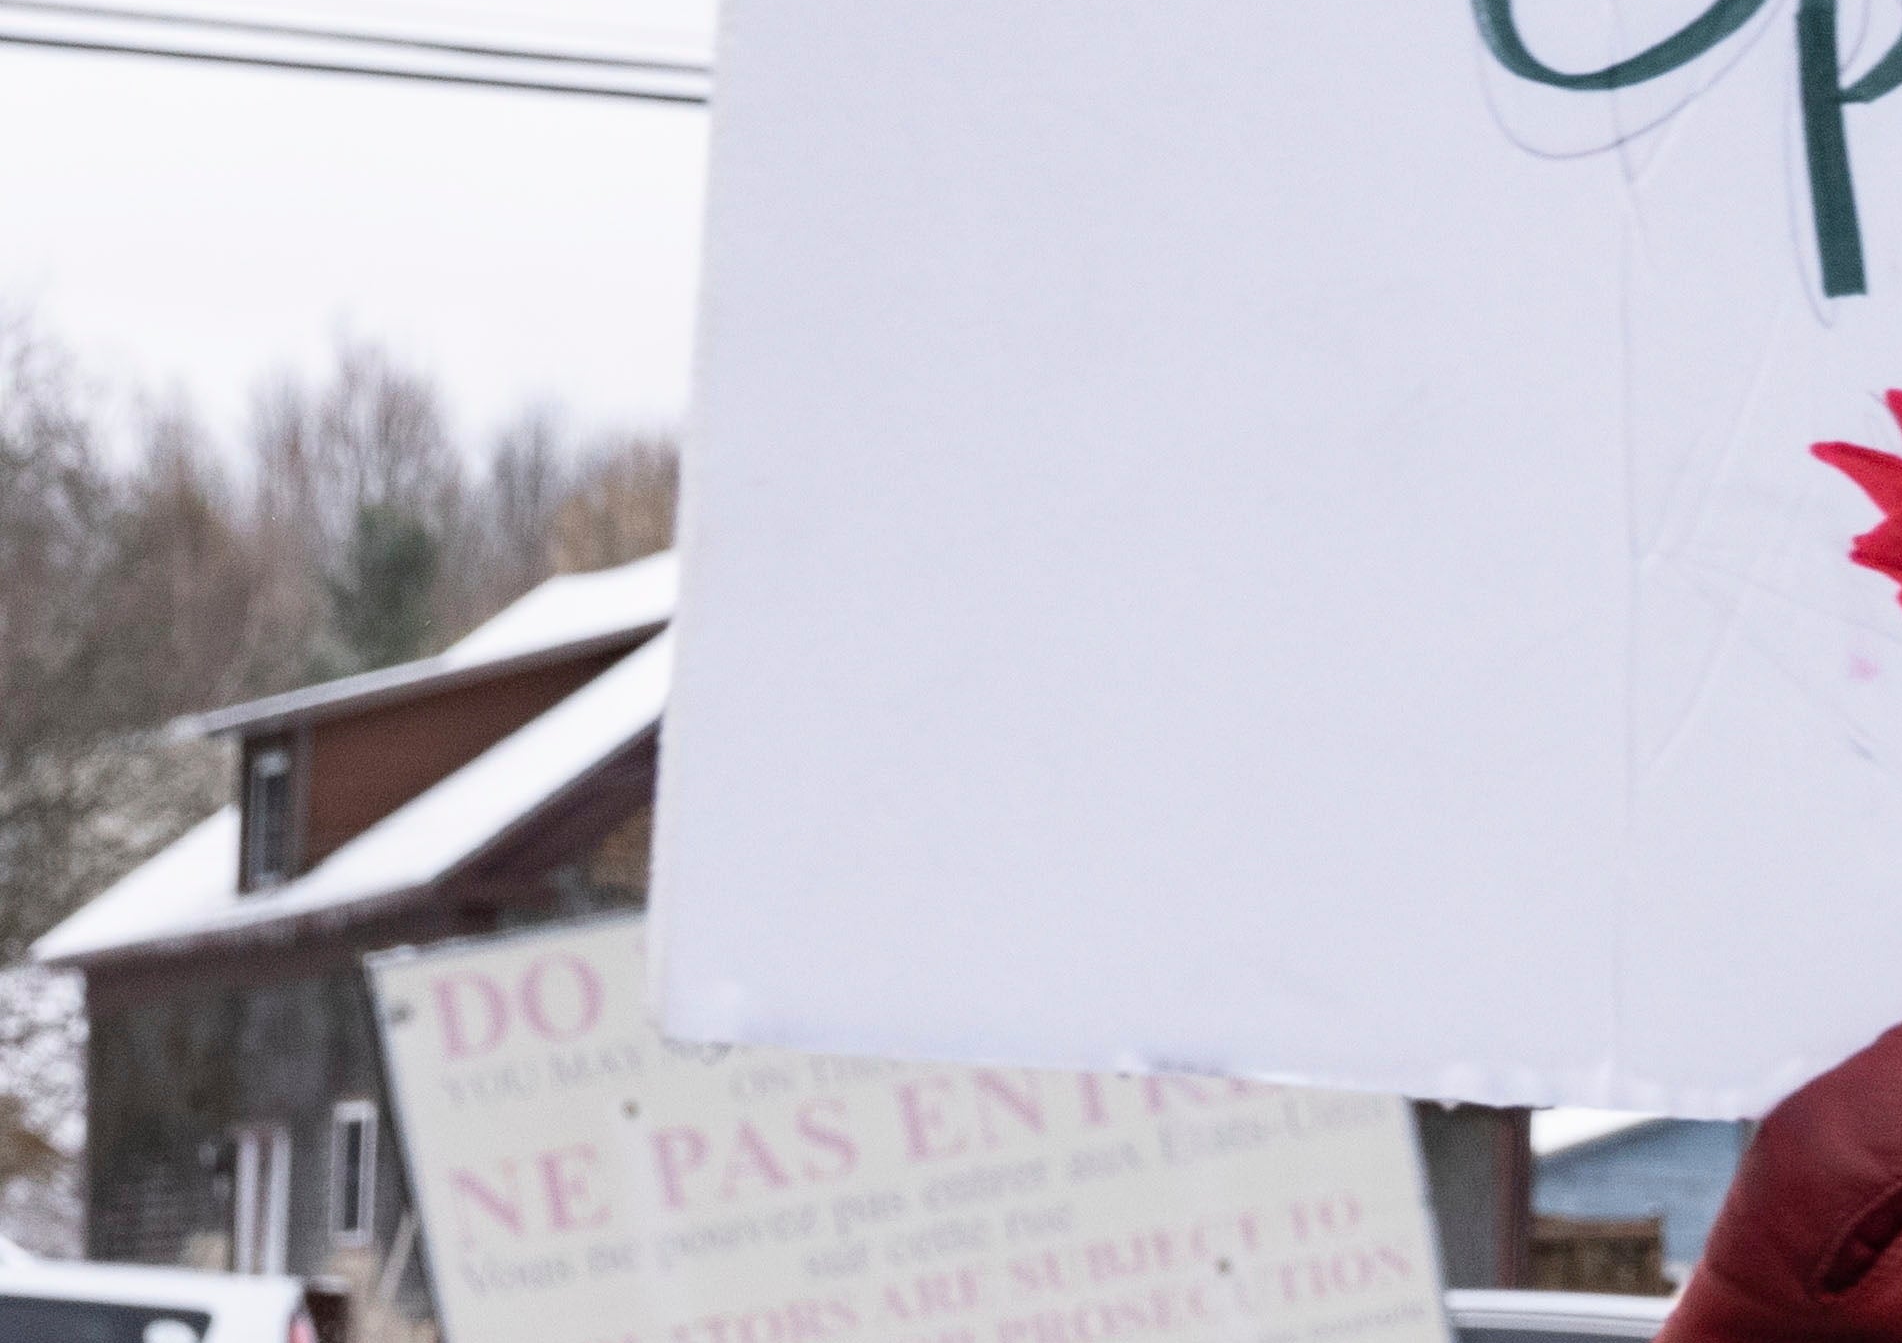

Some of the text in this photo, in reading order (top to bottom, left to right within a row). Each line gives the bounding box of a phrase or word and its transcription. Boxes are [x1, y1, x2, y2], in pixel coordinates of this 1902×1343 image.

[436, 951, 605, 1059] DO
[451, 1142, 612, 1252] NE
[651, 1097, 860, 1209] PAS
[882, 1266, 984, 1322] ARE
[1008, 1210, 1263, 1294] SUBJECT
[1288, 1191, 1364, 1242] TO
